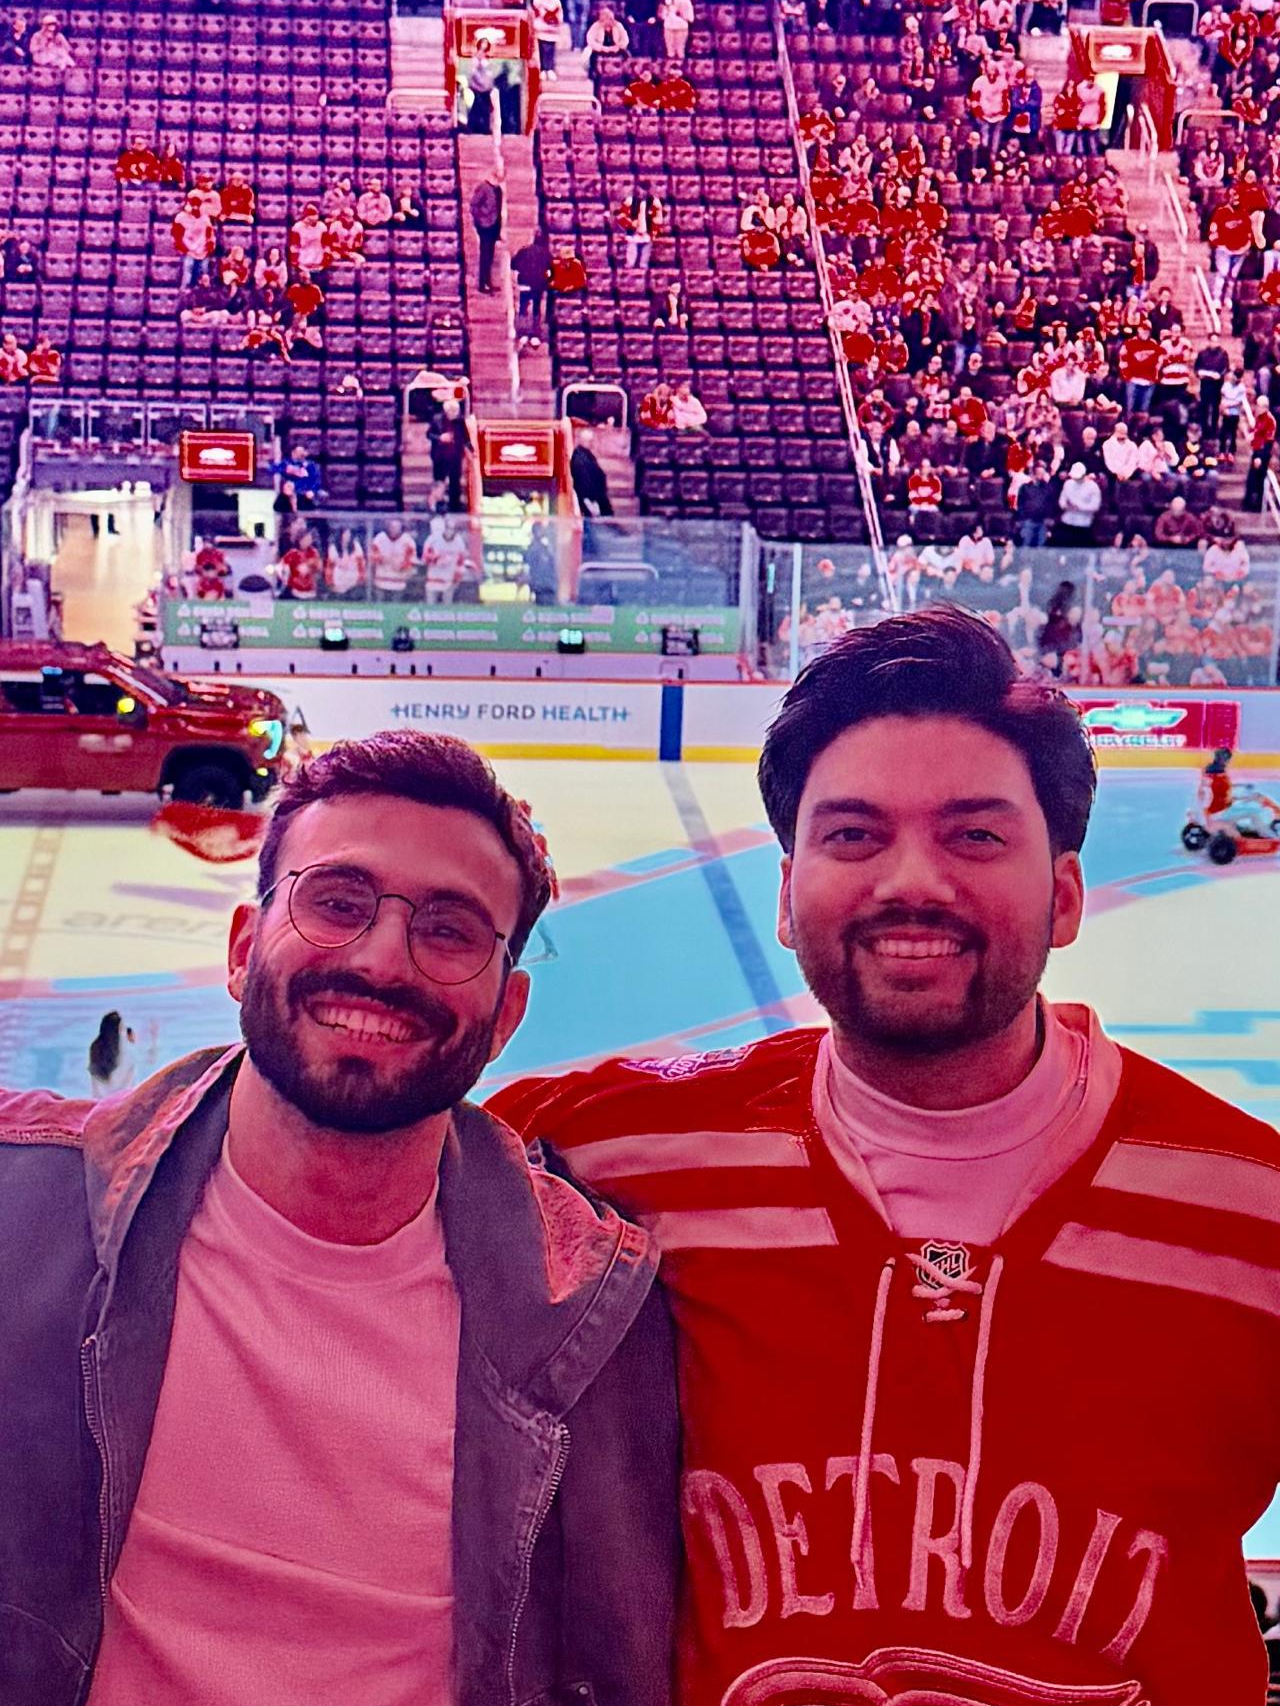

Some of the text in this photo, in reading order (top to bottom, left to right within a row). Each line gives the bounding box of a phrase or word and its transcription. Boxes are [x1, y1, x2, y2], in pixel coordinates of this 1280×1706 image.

[390, 703, 632, 722] HENRY FORD HEALTH
[681, 1455, 1169, 1663] DETROIT
